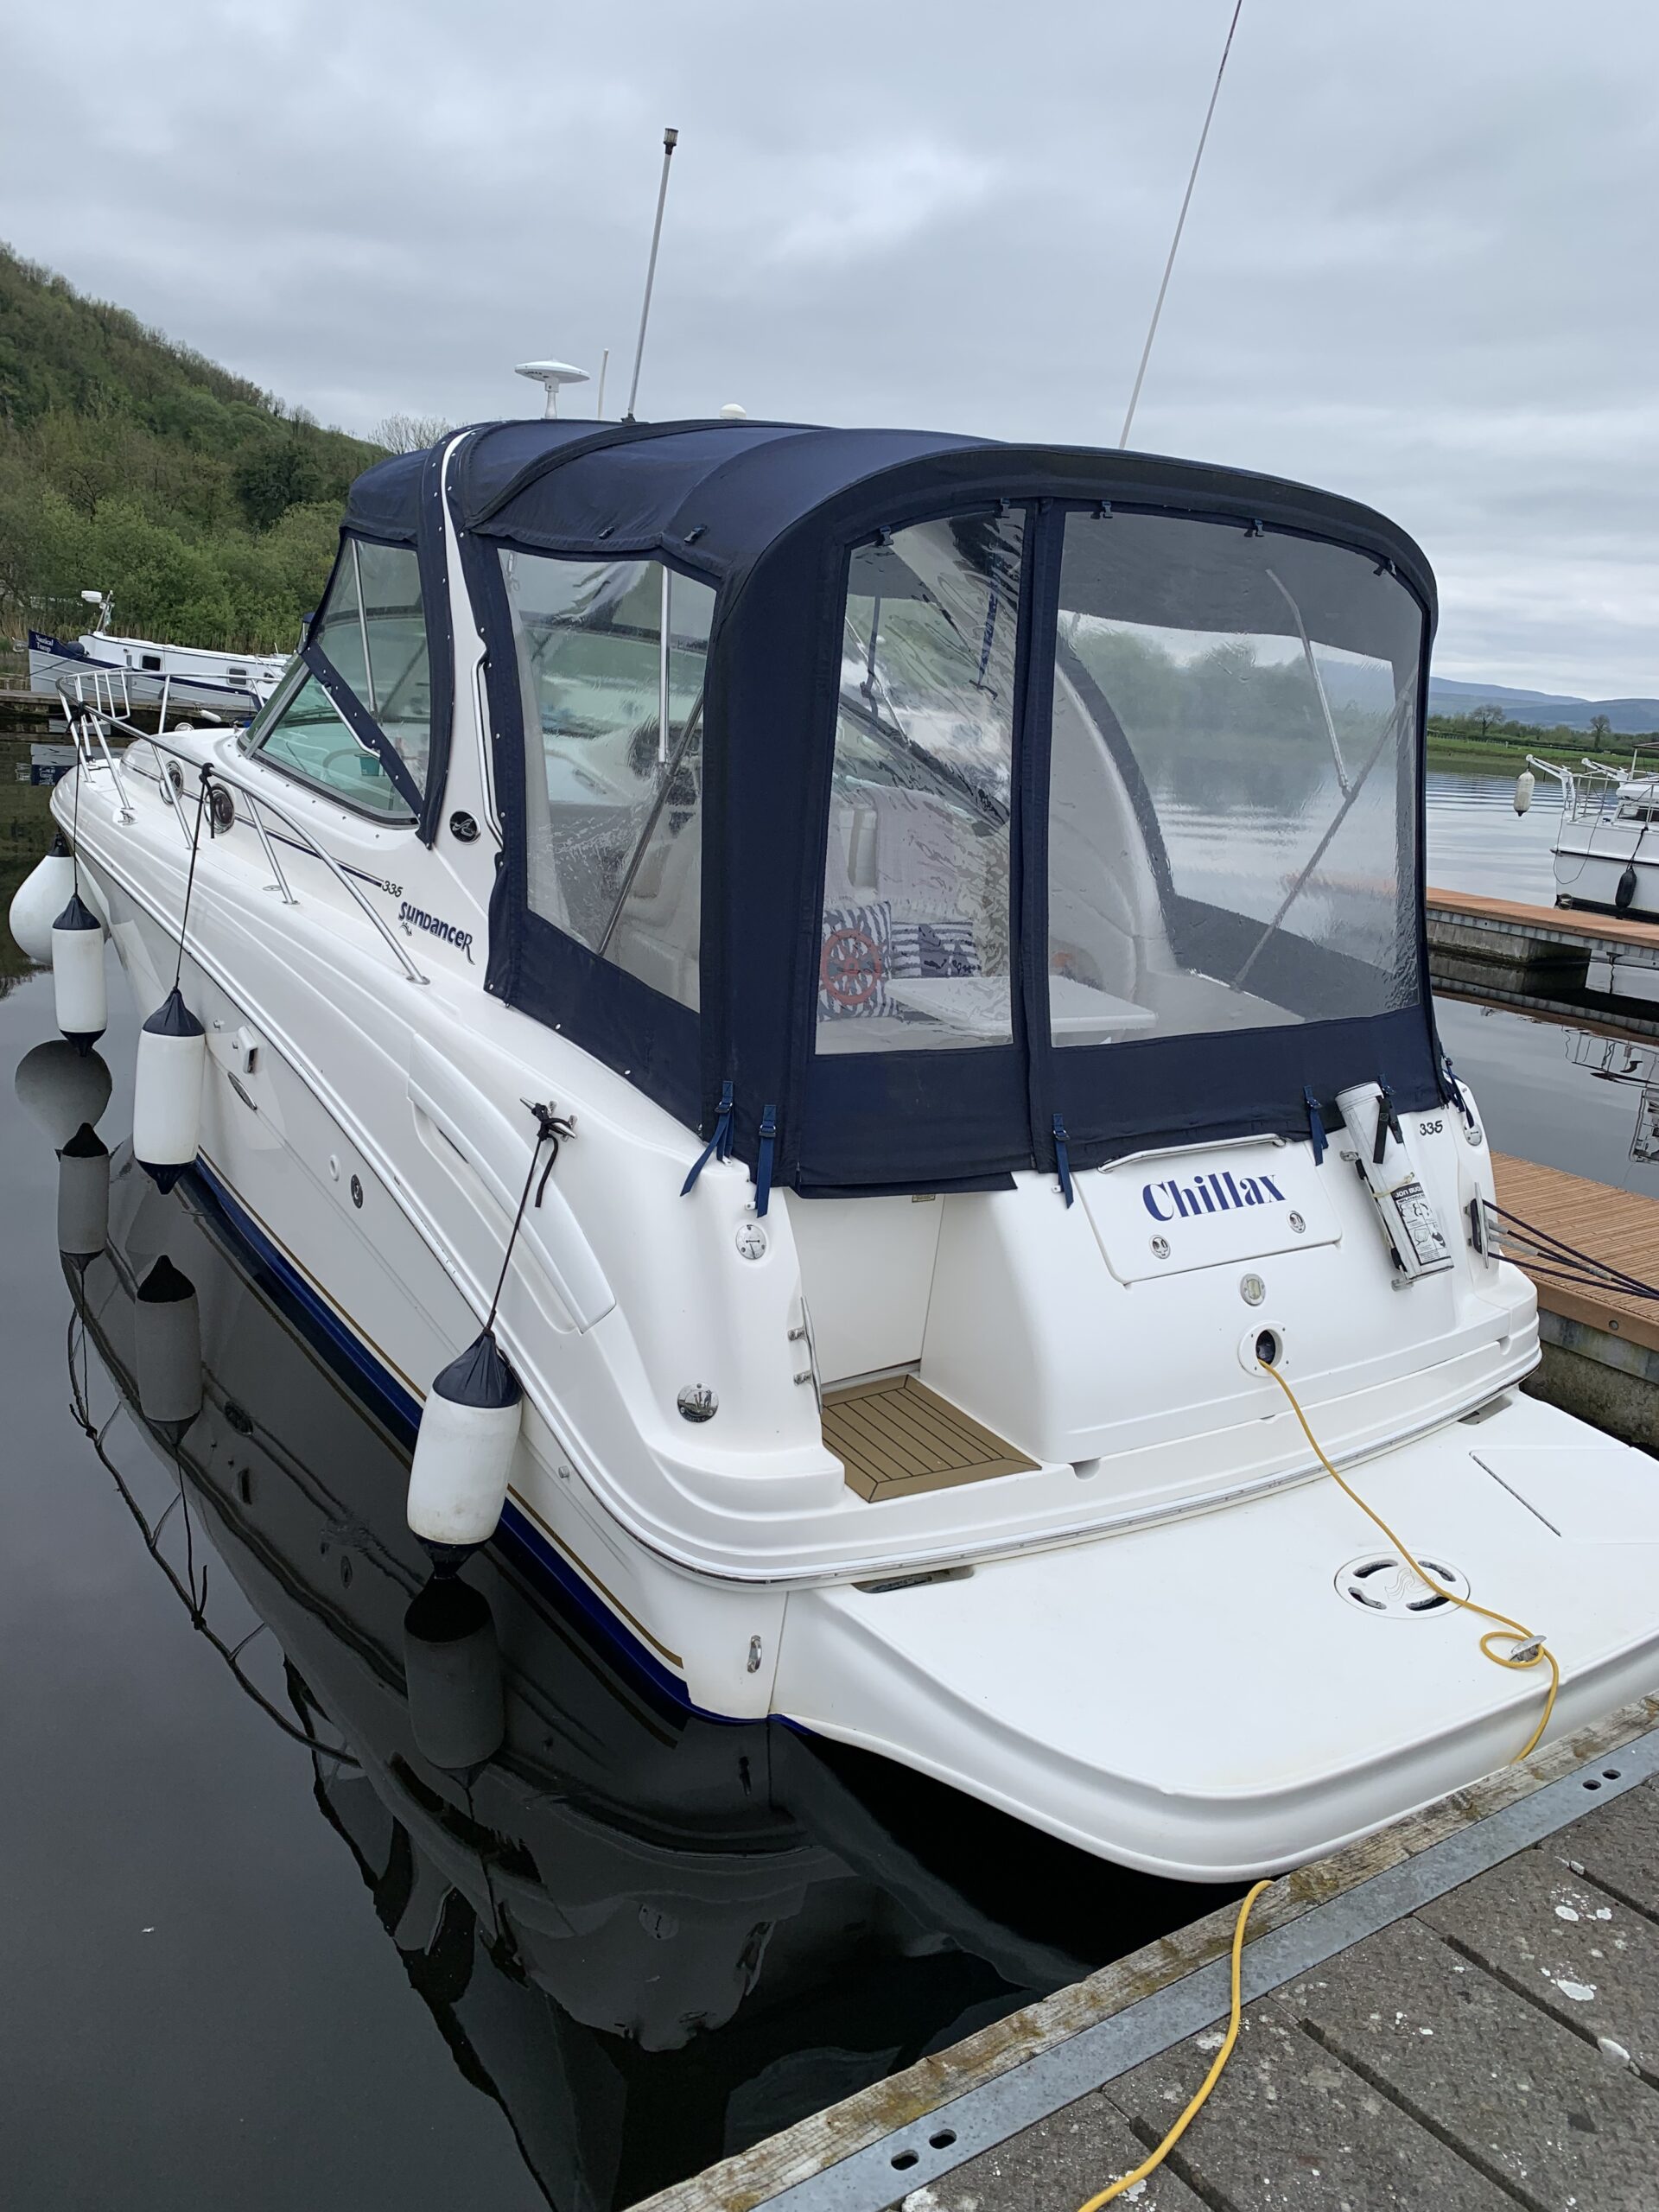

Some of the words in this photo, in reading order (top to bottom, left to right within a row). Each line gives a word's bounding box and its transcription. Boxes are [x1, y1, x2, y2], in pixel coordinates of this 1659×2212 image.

[382, 880, 404, 898] 335
[1420, 1120, 1443, 1136] 335
[1142, 1171, 1286, 1222] Chillax
